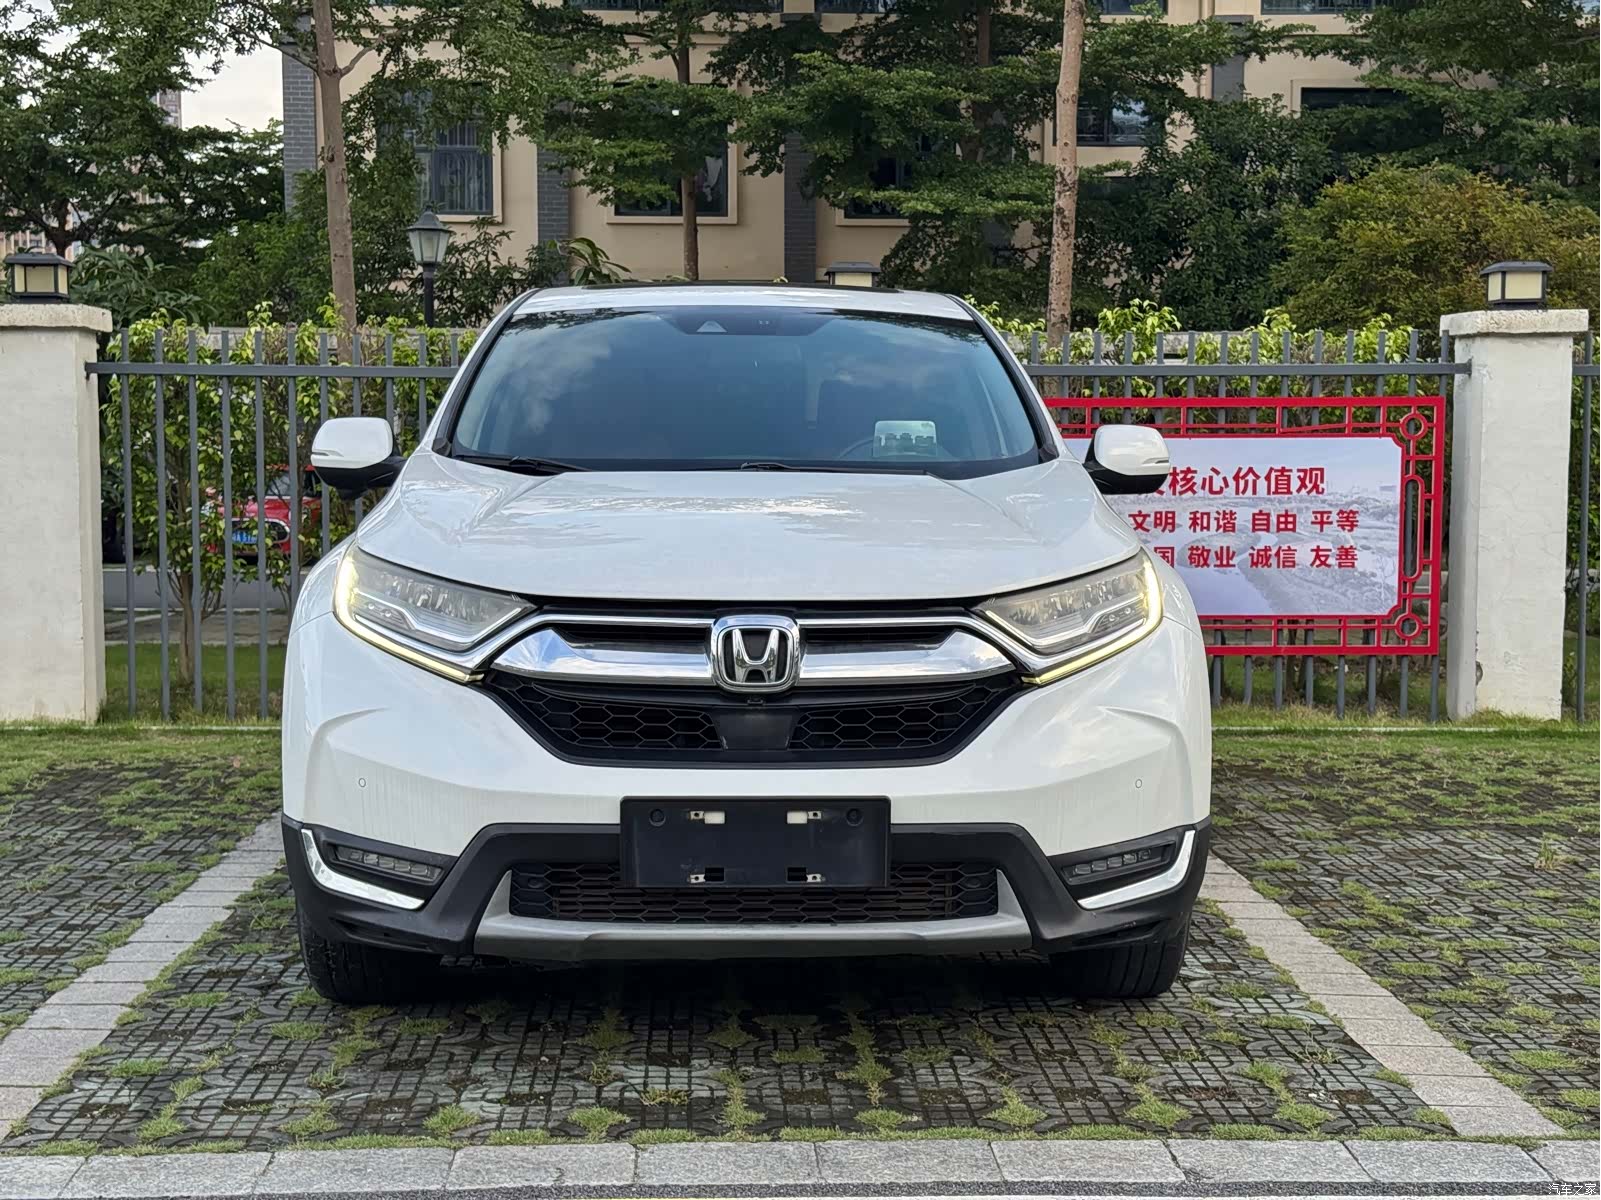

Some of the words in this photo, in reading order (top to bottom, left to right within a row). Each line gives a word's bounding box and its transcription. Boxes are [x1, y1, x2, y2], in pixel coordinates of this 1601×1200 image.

[1155, 466, 1325, 496] 核心价值观
[1128, 509, 1176, 533] 文明
[1189, 509, 1237, 533] 和谐
[1251, 509, 1297, 533] 自由
[1310, 509, 1359, 533] 平等
[1188, 546, 1236, 568] 敬业
[1248, 545, 1298, 569] 诚信
[1310, 545, 1358, 569] 友善
